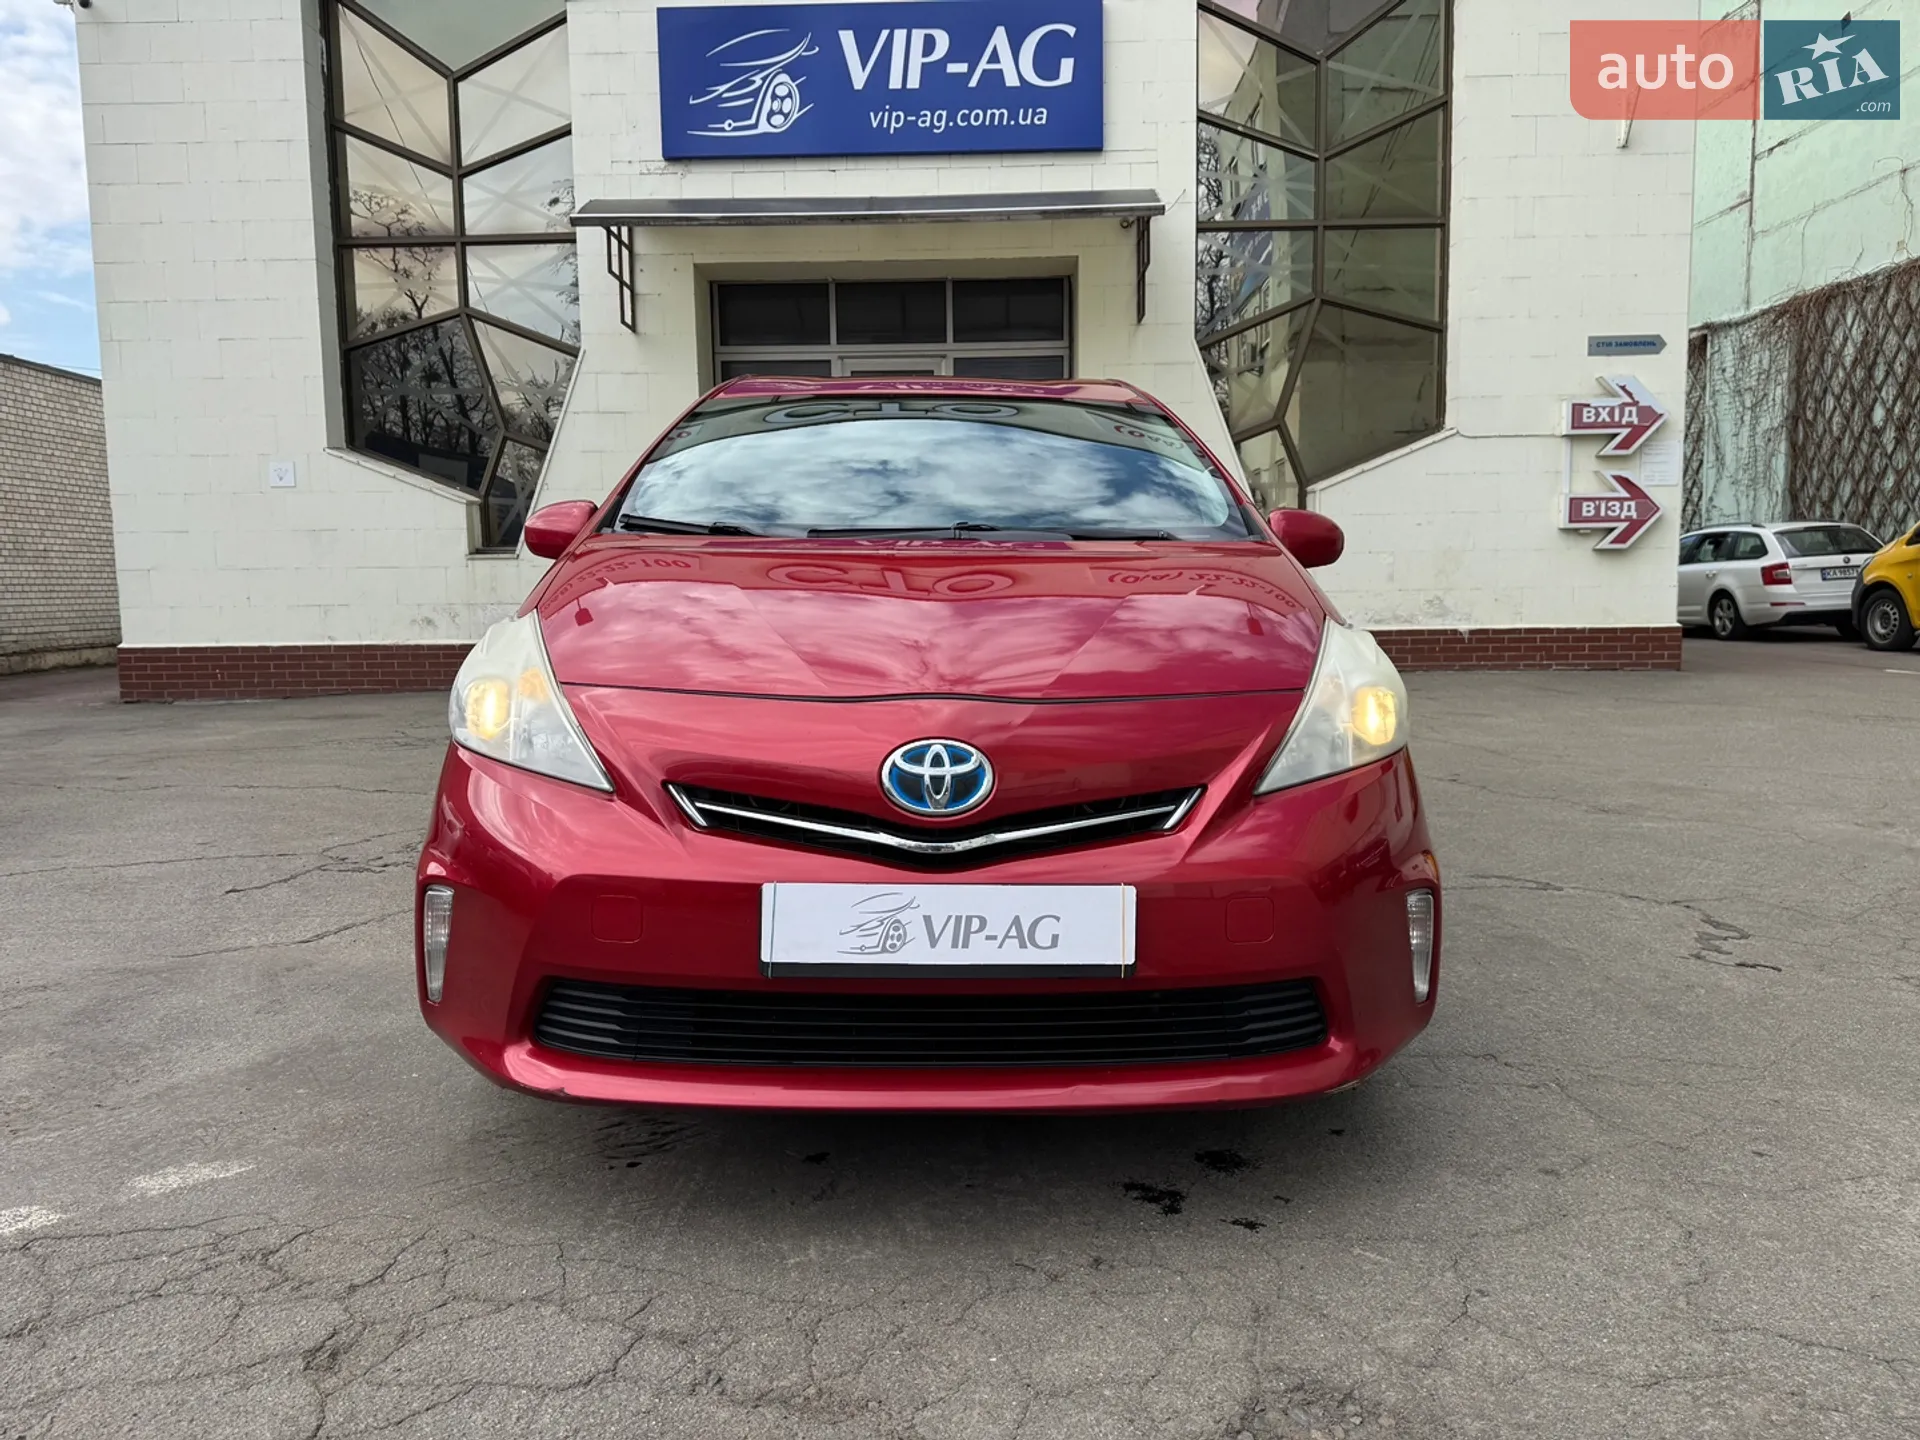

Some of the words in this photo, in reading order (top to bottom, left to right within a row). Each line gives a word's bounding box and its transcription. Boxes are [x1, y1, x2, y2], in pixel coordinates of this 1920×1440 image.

[838, 23, 1077, 90] VIP-AG
[869, 104, 1048, 134] vip-ag.com.ua
[1582, 406, 1639, 425] ВХІД
[922, 914, 1061, 951] VIP-AG
